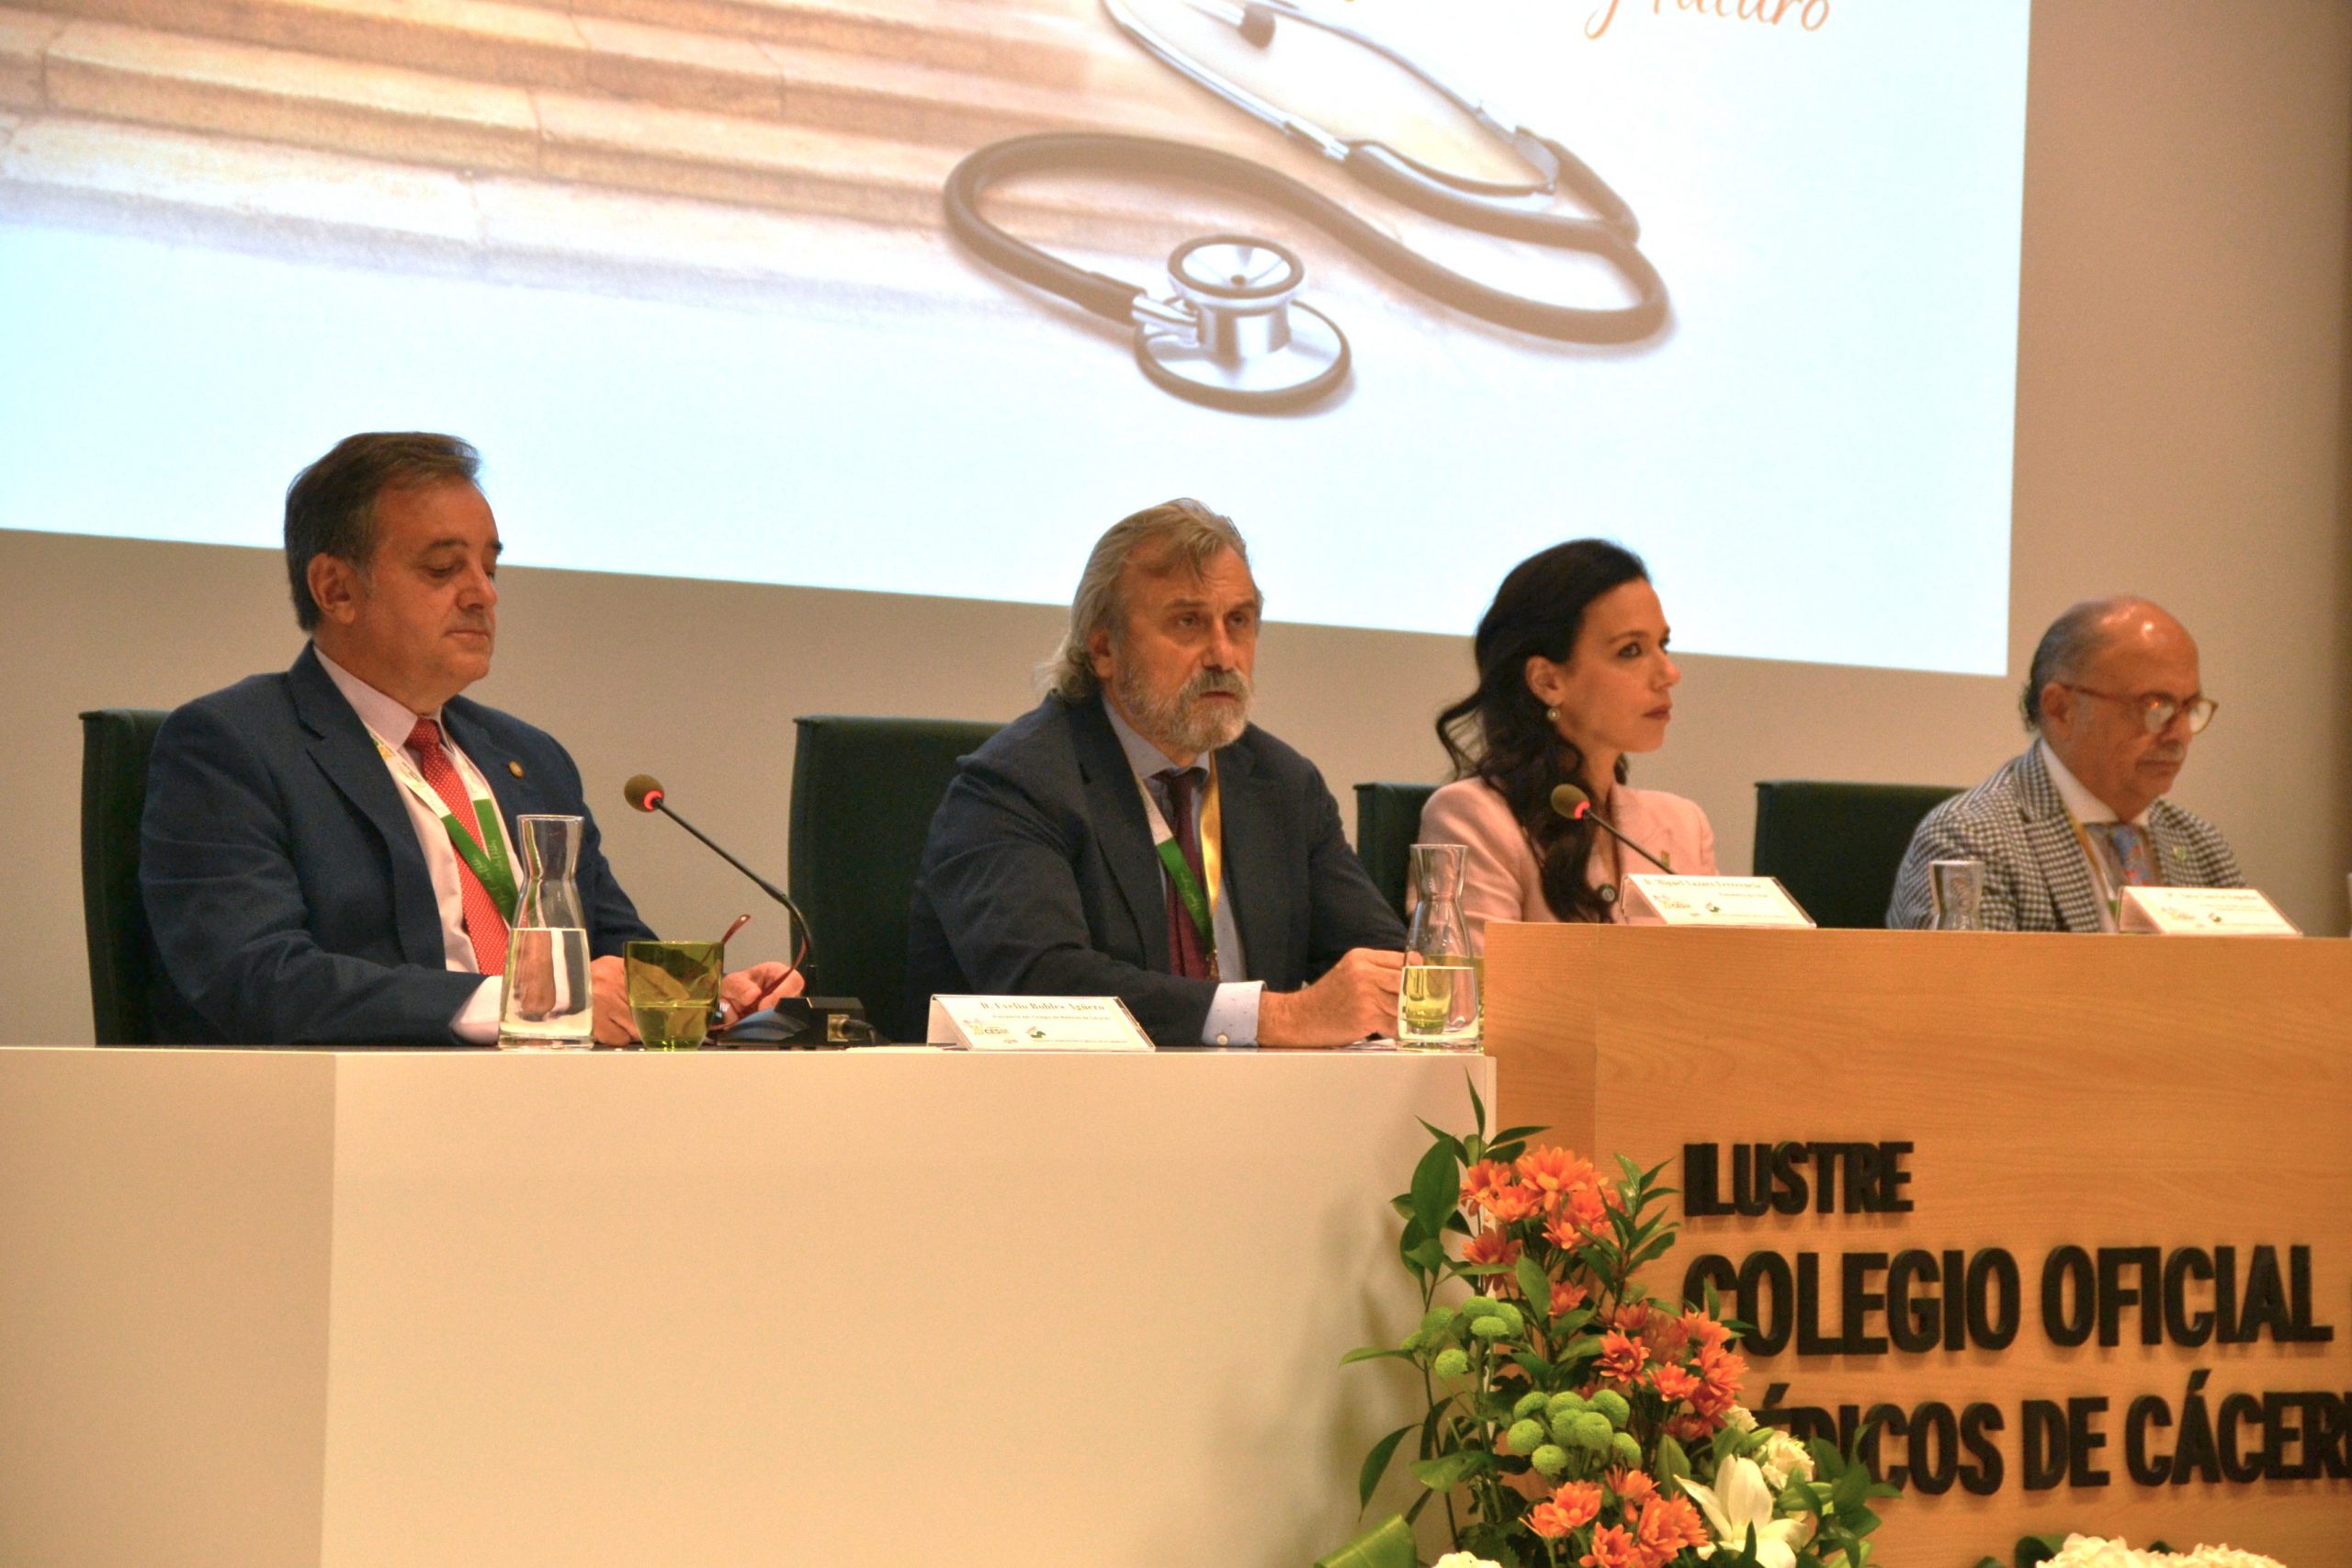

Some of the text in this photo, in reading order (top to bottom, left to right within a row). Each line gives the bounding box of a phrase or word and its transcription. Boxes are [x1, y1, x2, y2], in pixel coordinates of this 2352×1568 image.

[1653, 0, 1830, 31] uro
[1683, 1140, 1914, 1217] ILUSTRE
[1682, 1245, 2335, 1357] COLEGIO OFICIAL
[1700, 1368, 2352, 1496] ICOS DE CÁCER
